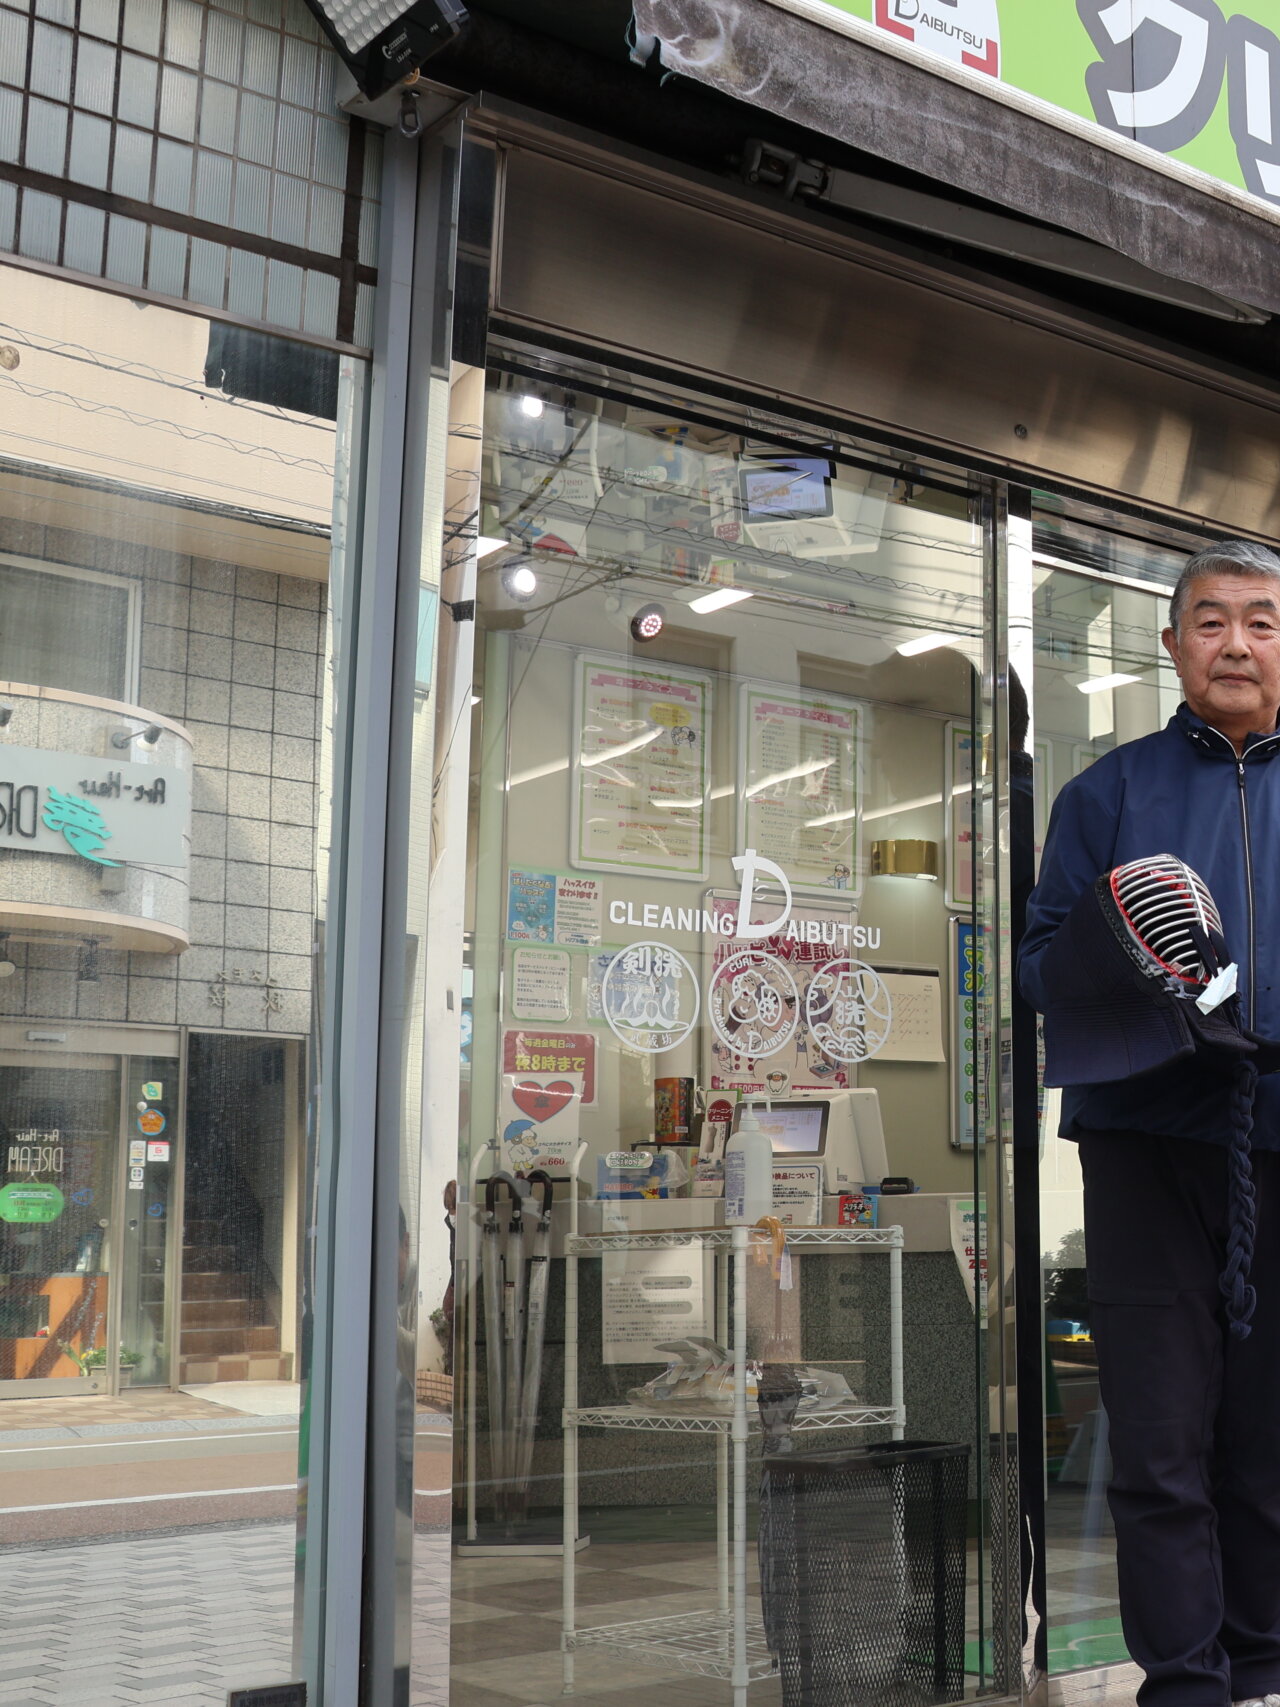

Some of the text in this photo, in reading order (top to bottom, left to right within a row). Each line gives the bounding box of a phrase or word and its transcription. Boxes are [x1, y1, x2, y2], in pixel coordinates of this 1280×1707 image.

[609, 900, 734, 936] CLEANING
[731, 849, 881, 949] DAIBUTSU
[514, 1054, 586, 1072] 夜8時まで
